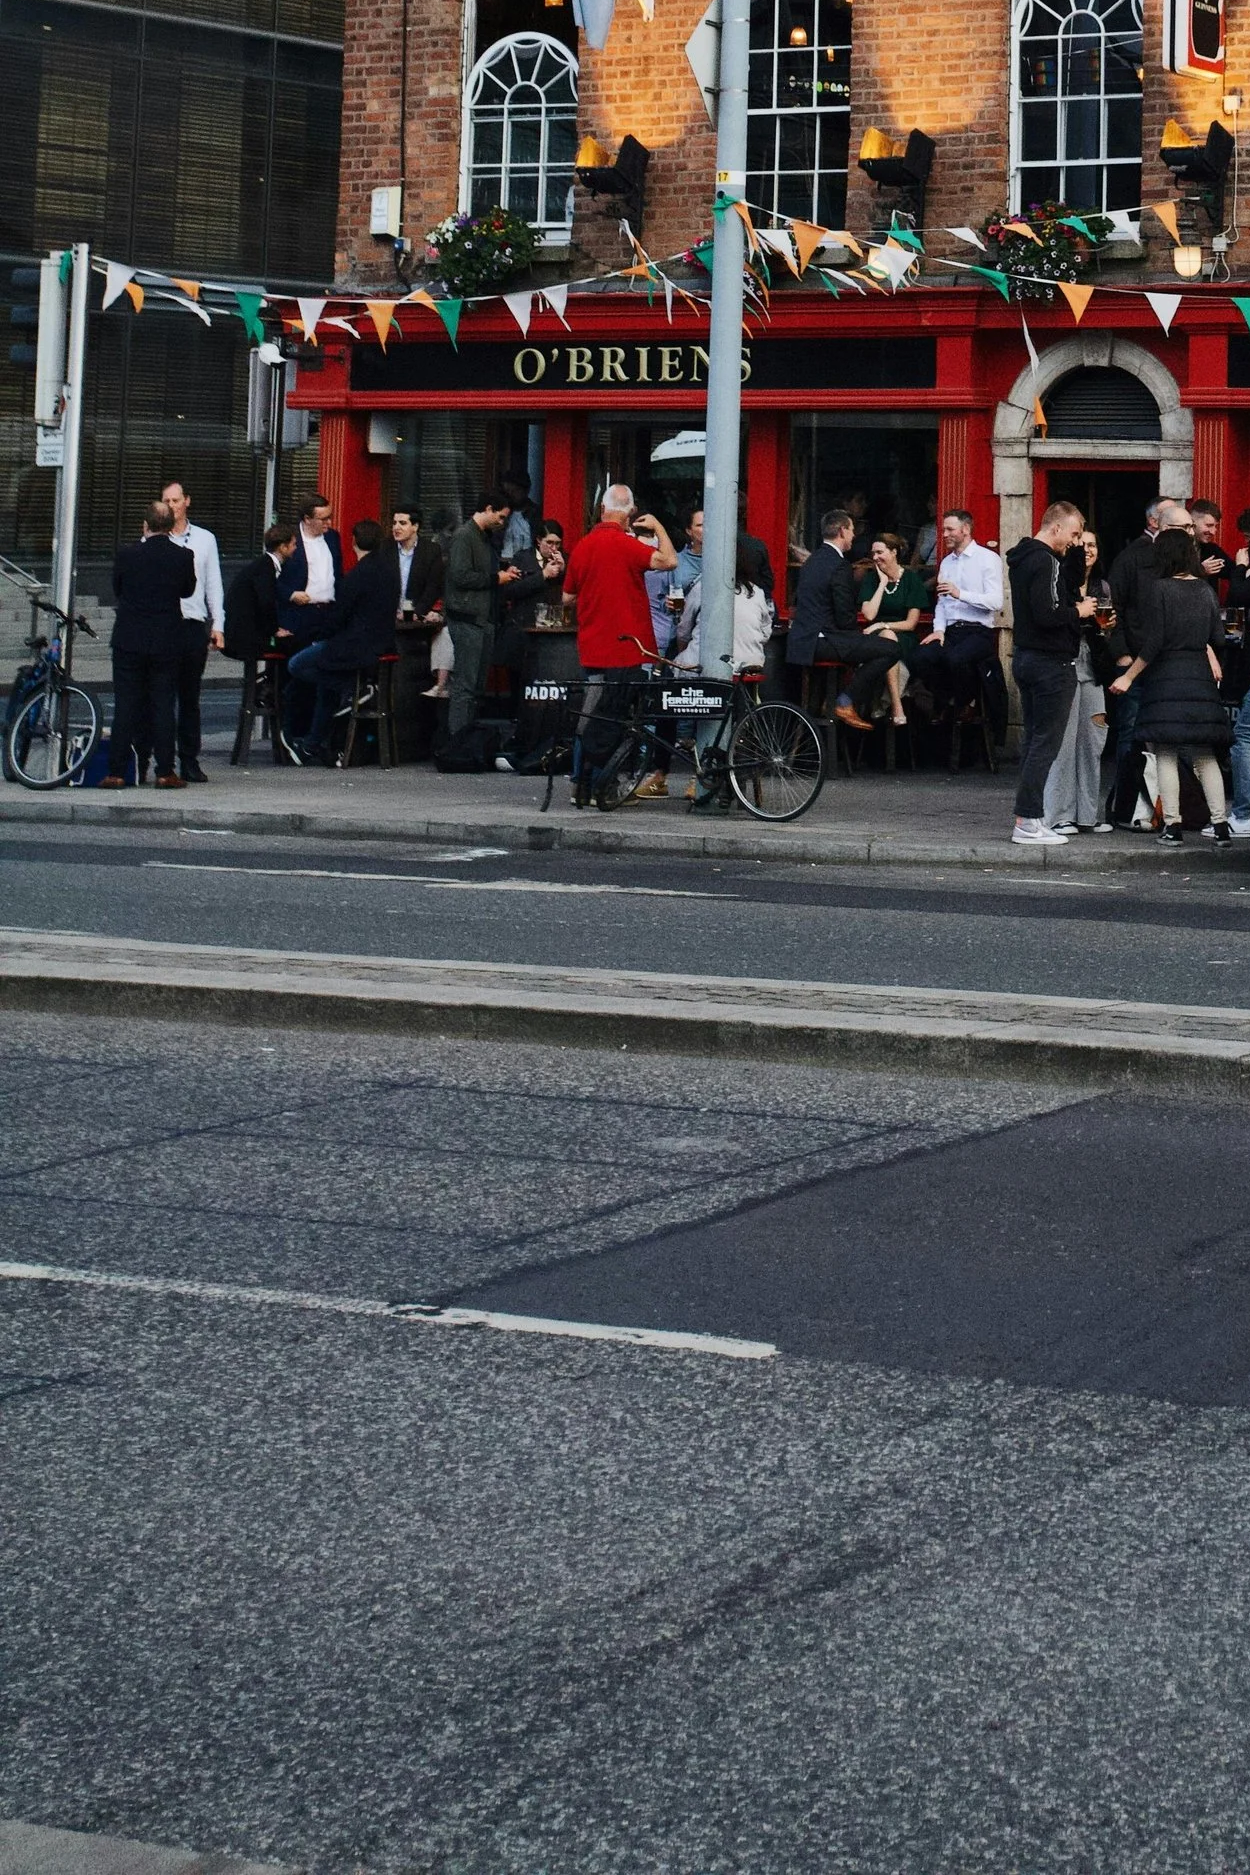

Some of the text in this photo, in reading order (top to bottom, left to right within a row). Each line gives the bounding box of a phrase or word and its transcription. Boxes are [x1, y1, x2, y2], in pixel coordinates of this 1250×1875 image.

[718, 172, 729, 182] 17
[524, 686, 568, 700] PADDY
[681, 687, 704, 697] the
